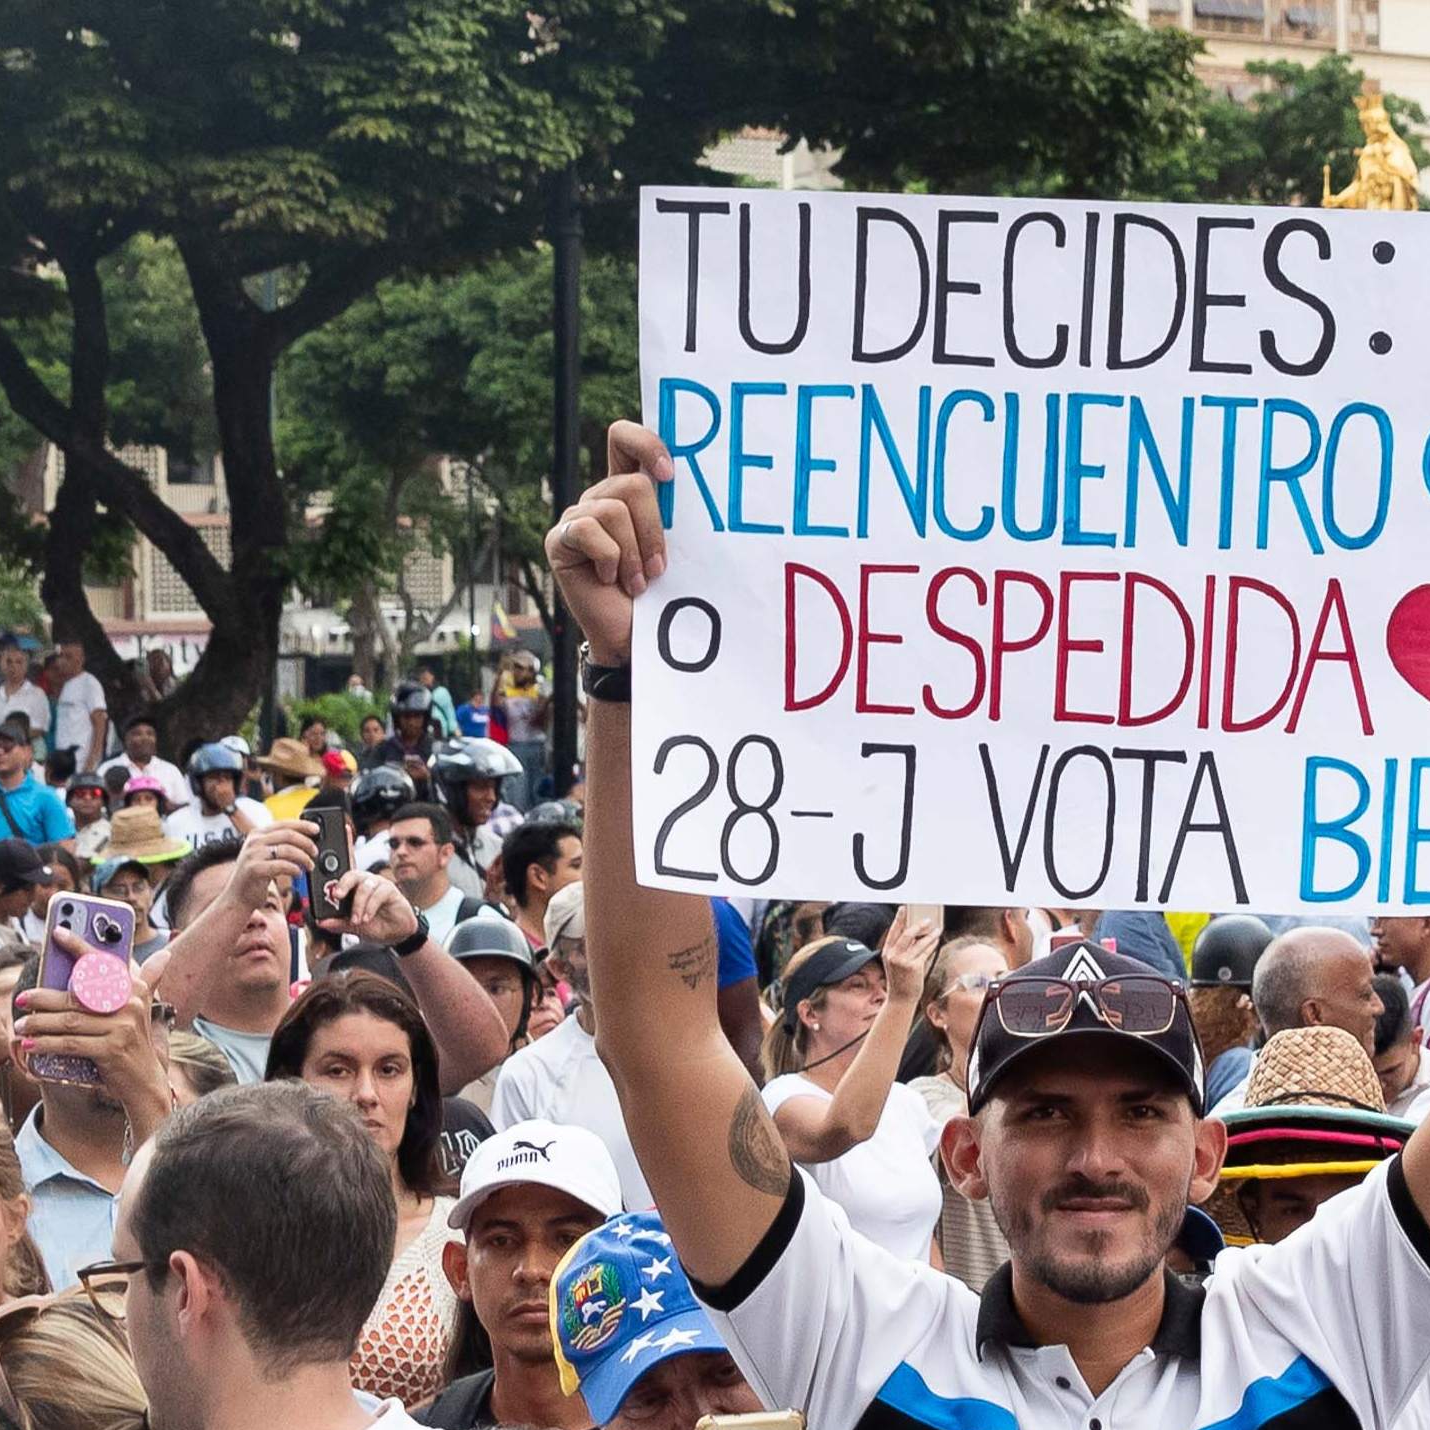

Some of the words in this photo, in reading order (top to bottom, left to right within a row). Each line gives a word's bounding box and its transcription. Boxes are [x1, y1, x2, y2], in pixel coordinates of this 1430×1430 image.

[656, 200, 811, 355] TU
[659, 378, 1396, 557] REENCUENTRO
[784, 562, 1375, 736] DESPEDIDA
[652, 734, 918, 891] 28-J
[977, 742, 1249, 905] VOTA
